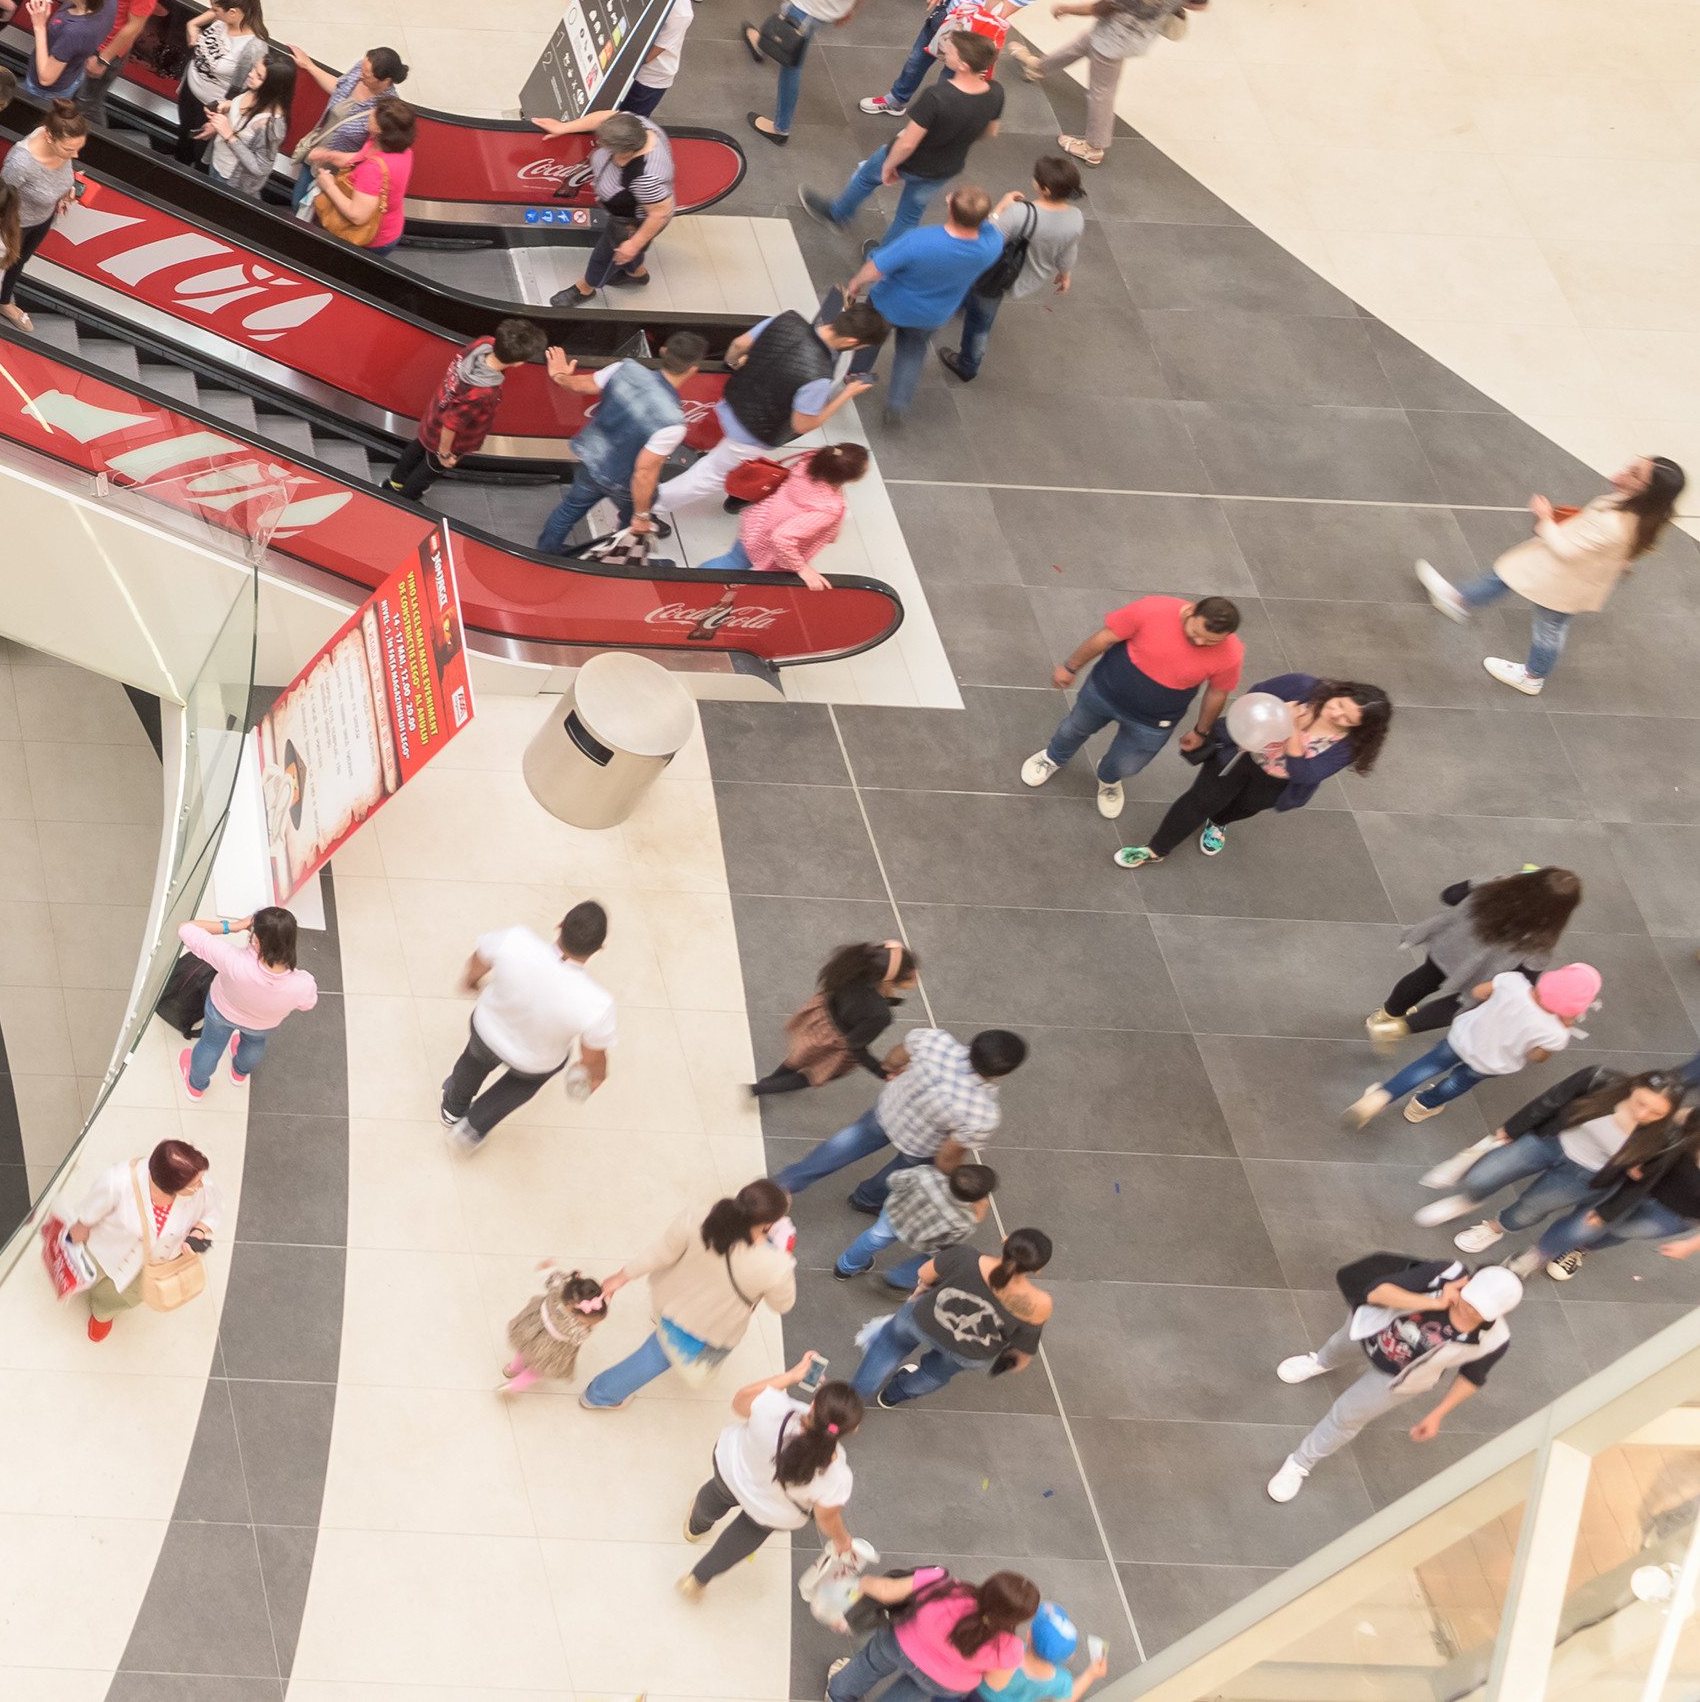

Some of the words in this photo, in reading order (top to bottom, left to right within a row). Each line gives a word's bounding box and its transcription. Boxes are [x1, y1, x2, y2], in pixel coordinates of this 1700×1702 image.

[398, 577, 406, 598] DE
[406, 568, 416, 599] VINO
[380, 596, 390, 627] NIVEL
[410, 595, 418, 612] LA
[412, 607, 421, 630] CEL
[644, 602, 791, 629] Coca-Cola
[395, 628, 403, 647] 17
[415, 624, 424, 651] MAI
[396, 641, 406, 671] MAI,
[418, 645, 428, 680] MARE
[400, 665, 411, 700] 12.00
[414, 690, 422, 710] AL
[422, 674, 438, 739] EVENIMENT
[405, 699, 416, 734] 20.00
[416, 704, 428, 748] ANULUI
